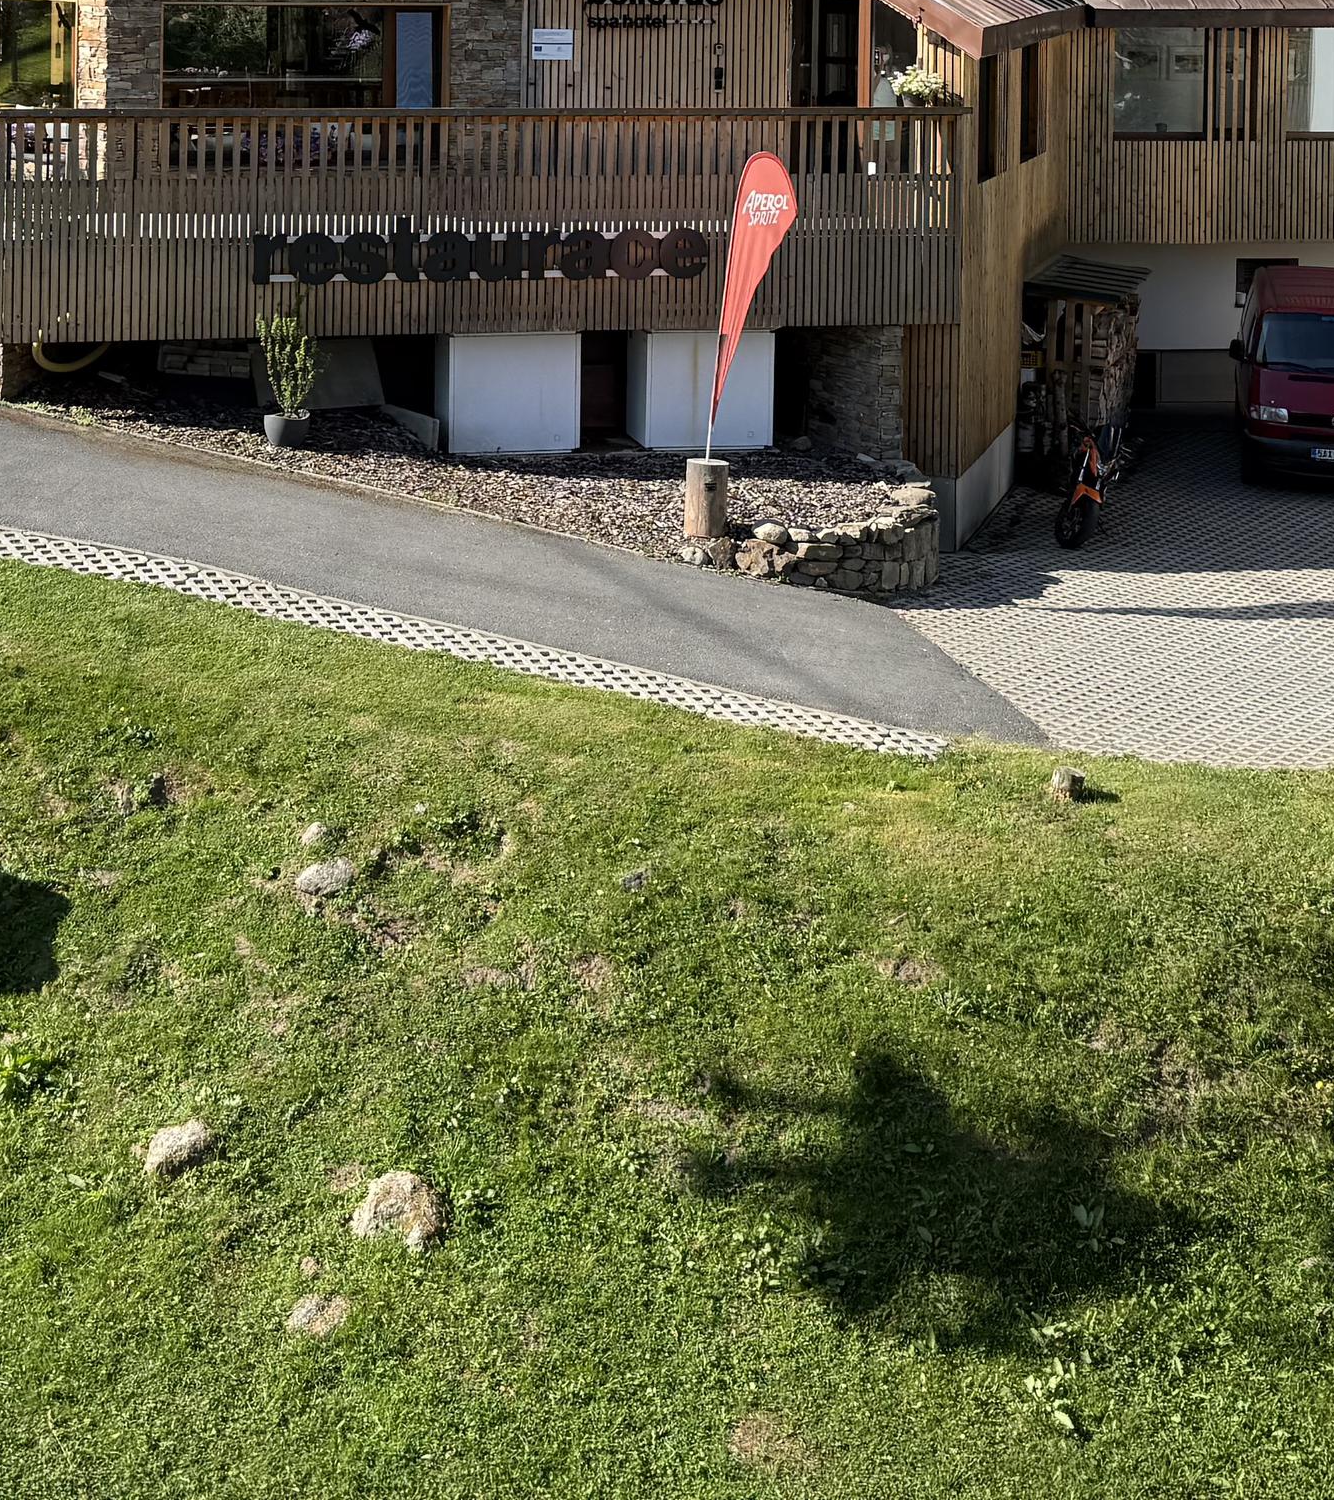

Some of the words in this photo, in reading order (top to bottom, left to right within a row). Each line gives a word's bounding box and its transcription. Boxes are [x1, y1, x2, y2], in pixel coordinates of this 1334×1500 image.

[587, 17, 621, 32] spa
[622, 14, 667, 28] hotel
[742, 190, 789, 214] APEROL
[748, 210, 779, 226] SPRITZ
[252, 216, 708, 284] restaurace
